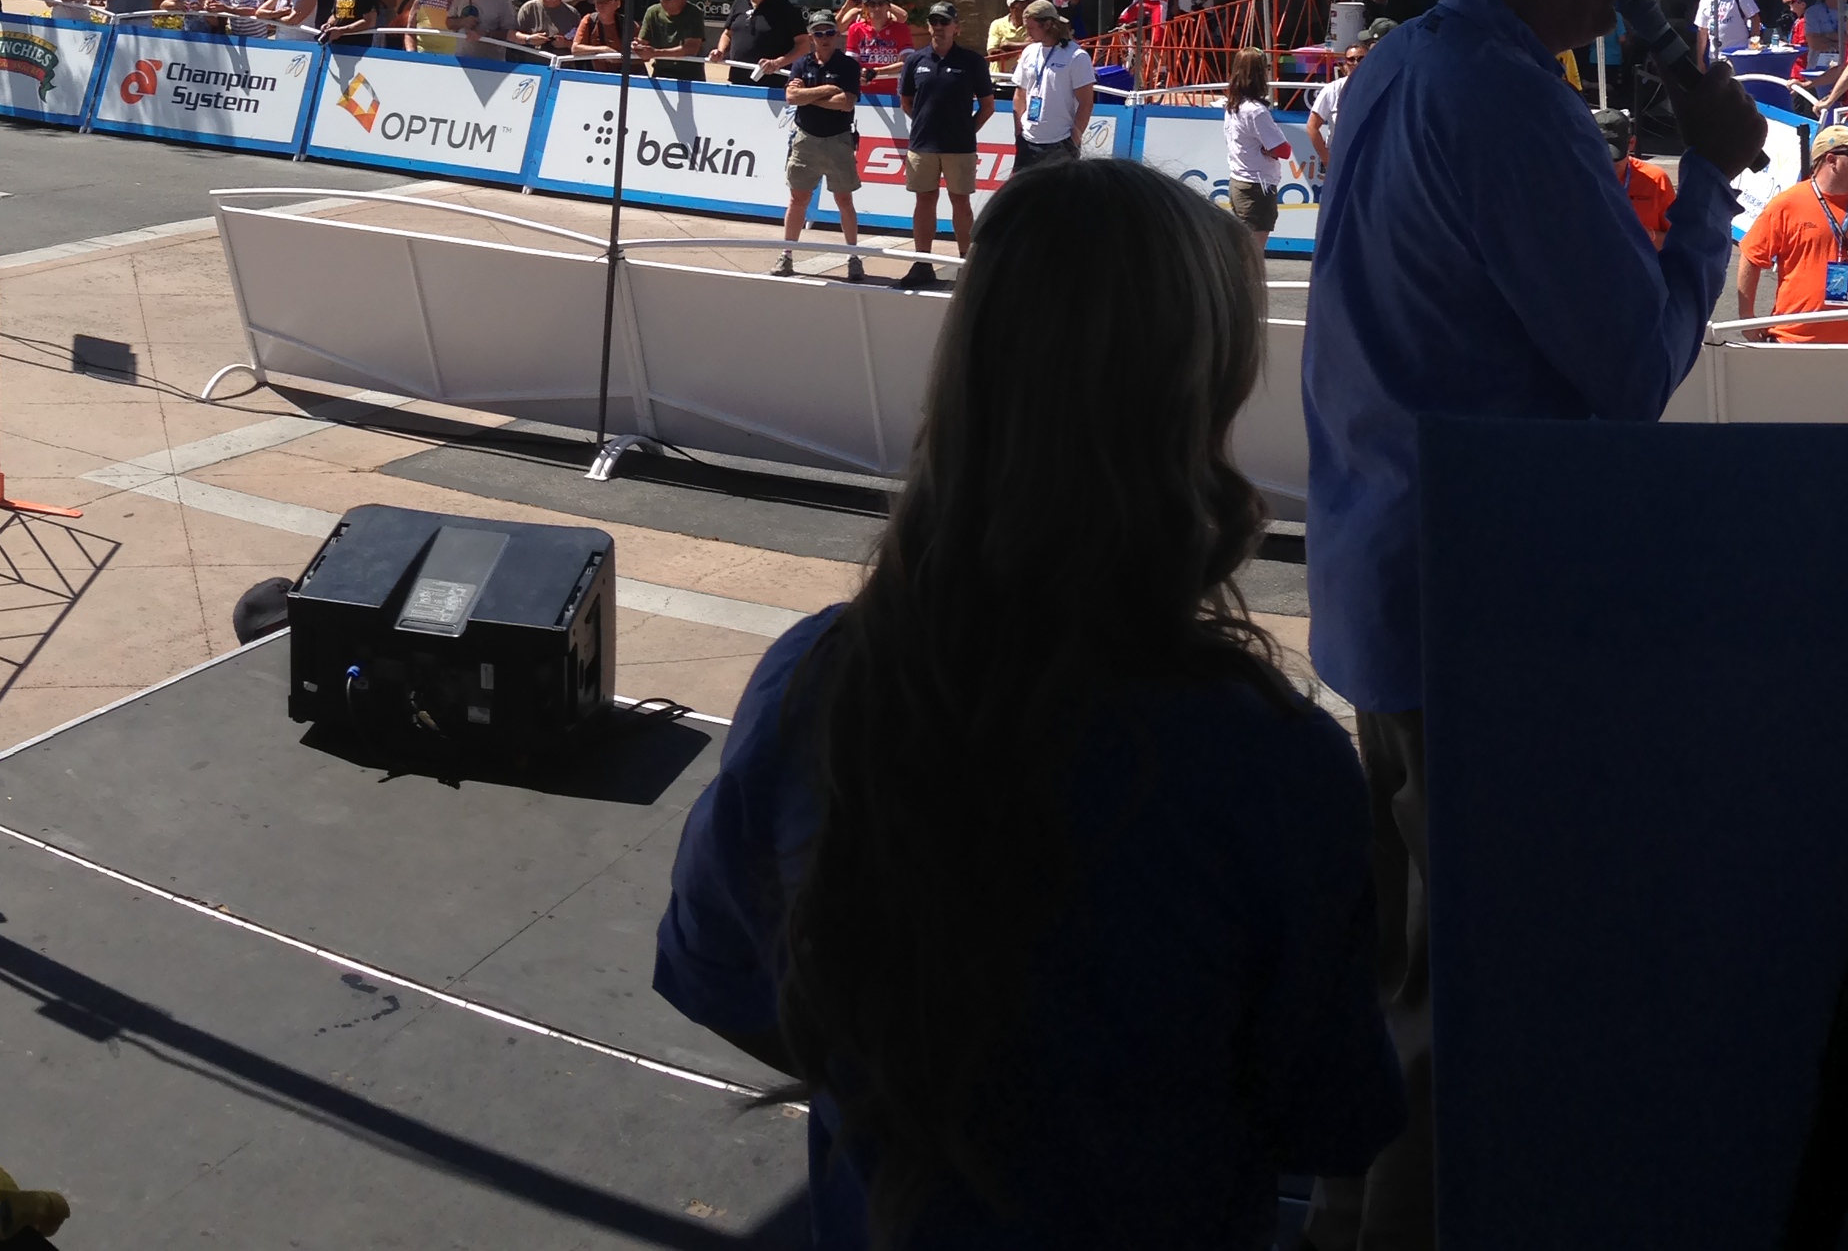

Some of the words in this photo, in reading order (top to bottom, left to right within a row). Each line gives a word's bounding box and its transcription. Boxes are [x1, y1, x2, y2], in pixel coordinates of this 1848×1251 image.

[167, 62, 277, 92] Champion
[171, 85, 260, 113] System
[381, 113, 497, 154] OPTUM
[637, 130, 755, 177] belkin
